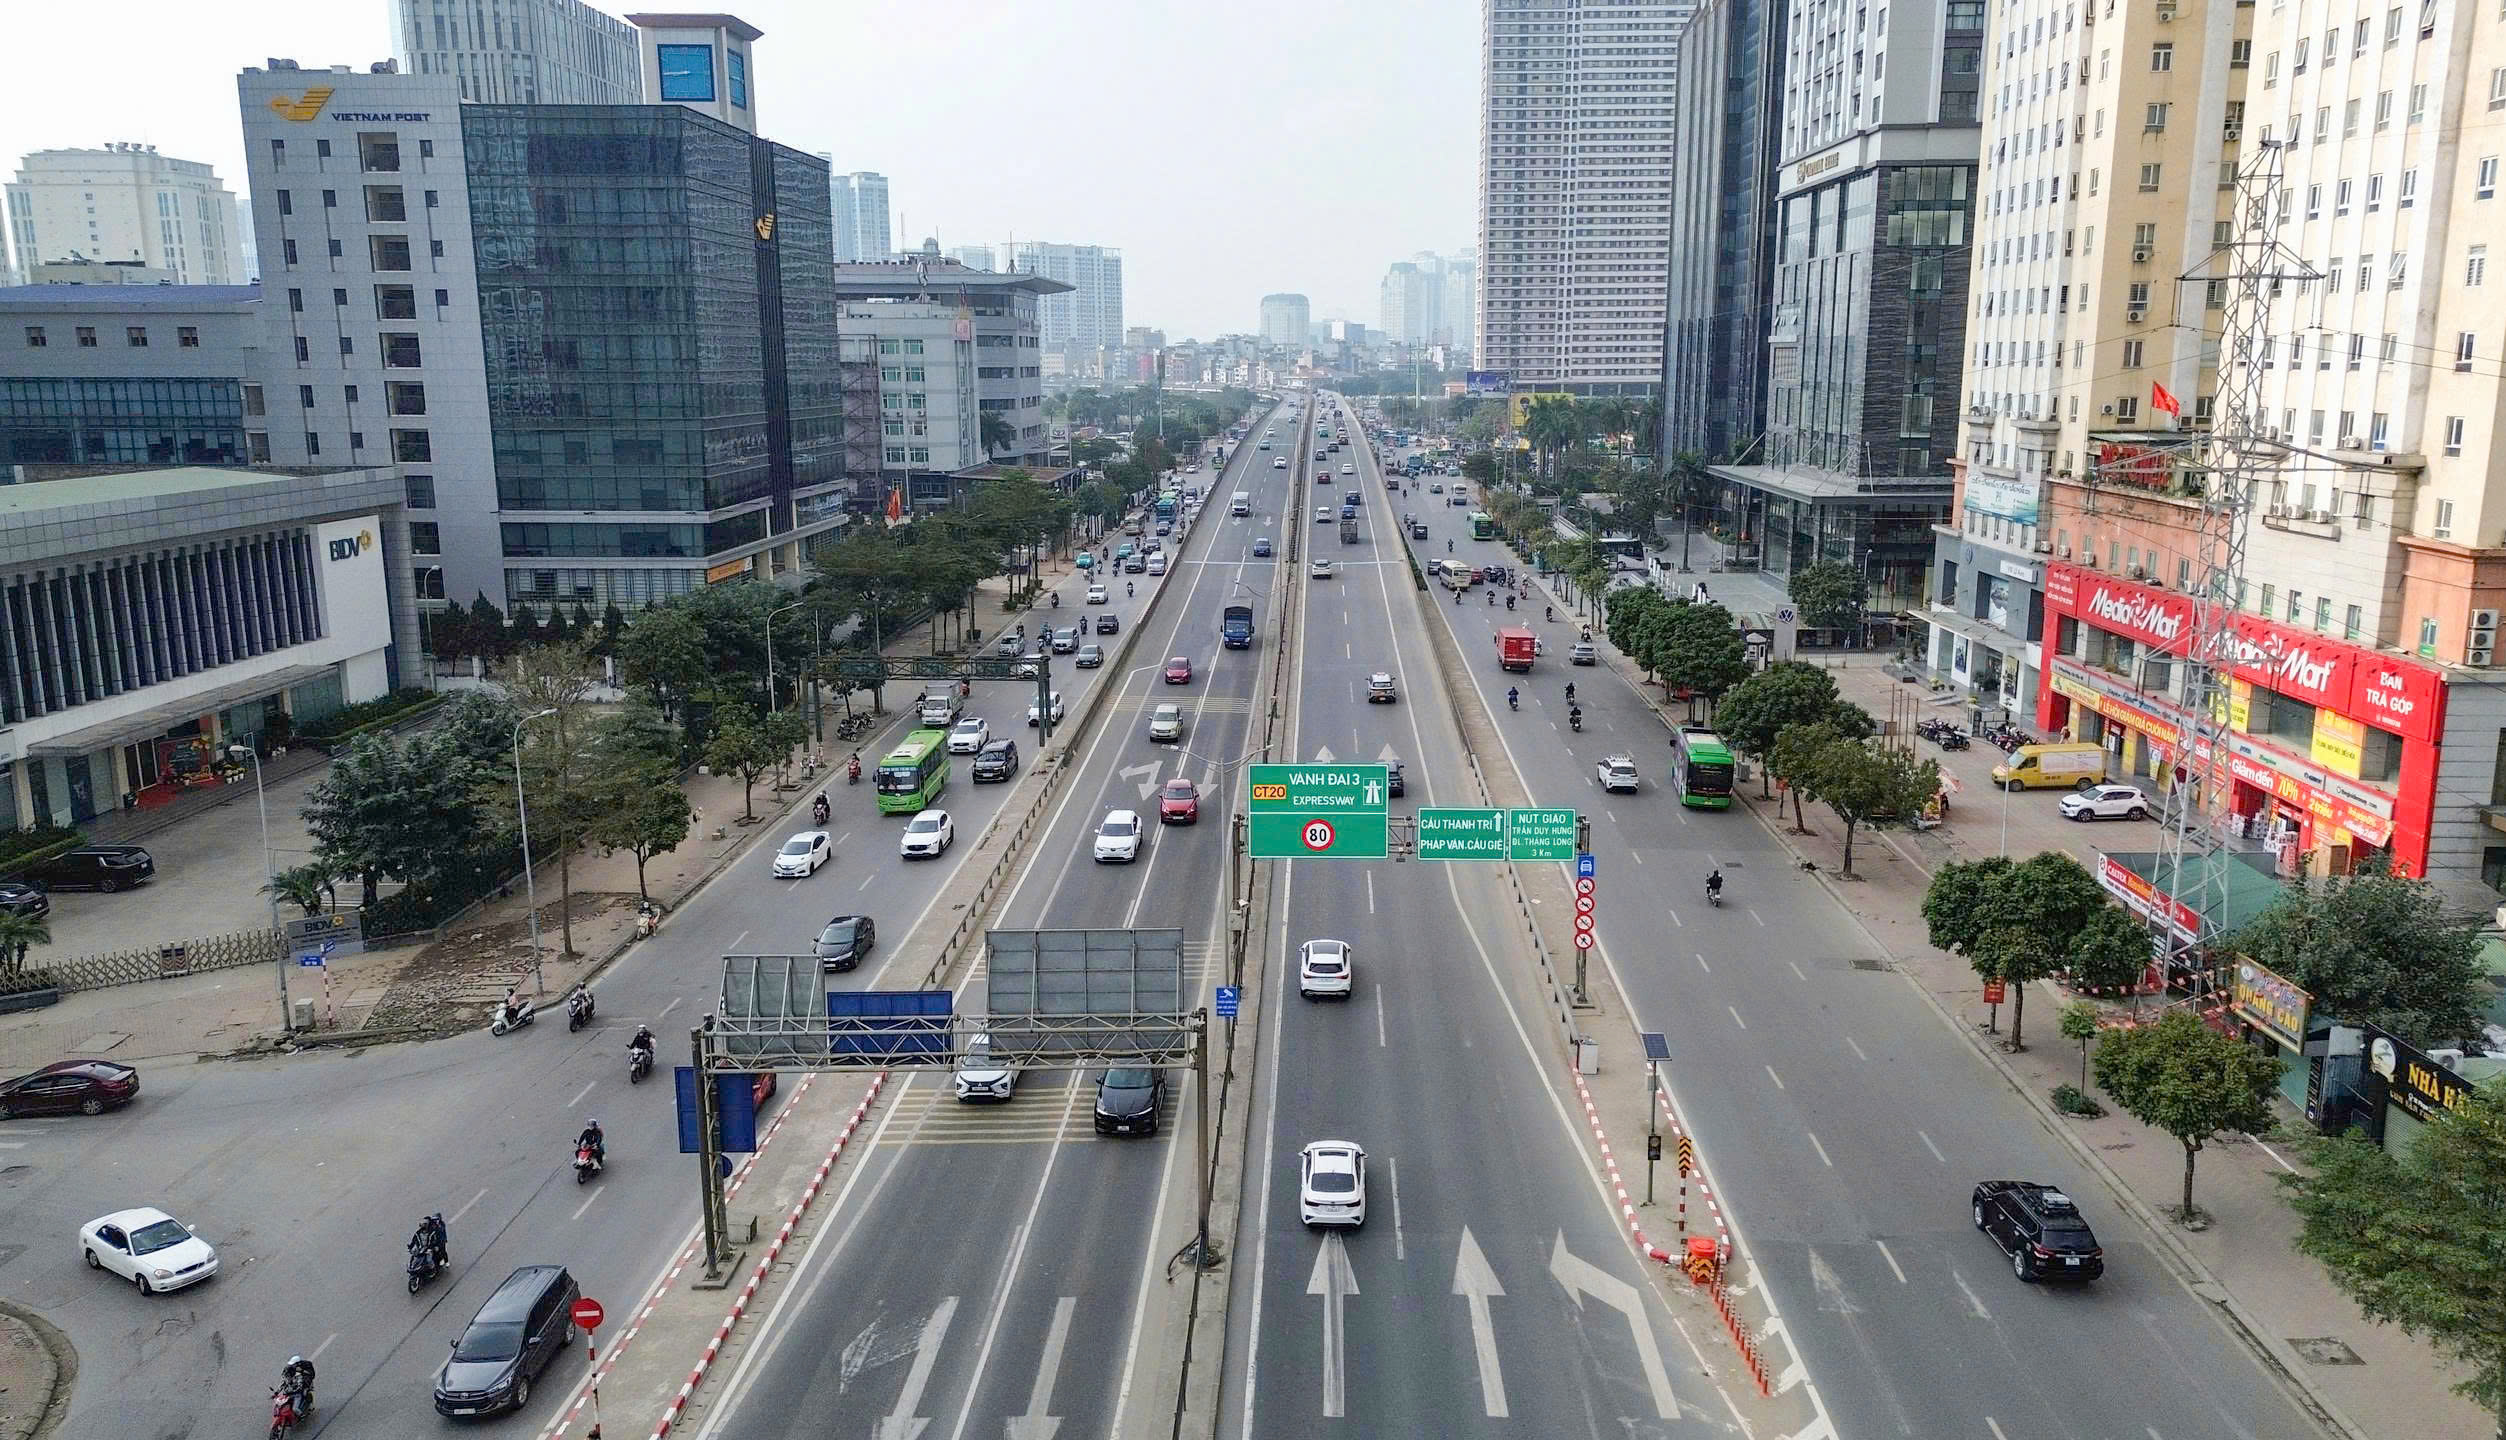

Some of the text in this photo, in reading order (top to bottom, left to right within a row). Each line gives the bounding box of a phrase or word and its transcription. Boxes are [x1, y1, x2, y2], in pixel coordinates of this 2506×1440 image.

[331, 112, 431, 122] VIETNAM POST
[329, 535, 362, 562] BIDV
[2088, 587, 2183, 641] Media Mart
[2280, 647, 2332, 693] Mart
[2390, 697, 2414, 715] GÓP
[1352, 773, 1360, 785] 3
[1293, 796, 1355, 805] EXPRESSWAY
[1442, 819, 1475, 830] THANH
[1542, 813, 1566, 824] GIAO
[1309, 828, 1327, 842] 80
[1534, 826, 1549, 835] DUY
[1420, 837, 1446, 850] PHÁP
[1552, 837, 1572, 846] LONG
[1531, 848, 1552, 857] 3 Km
[304, 919, 333, 933] BIDV
[2408, 1063, 2440, 1102] NHÀ
